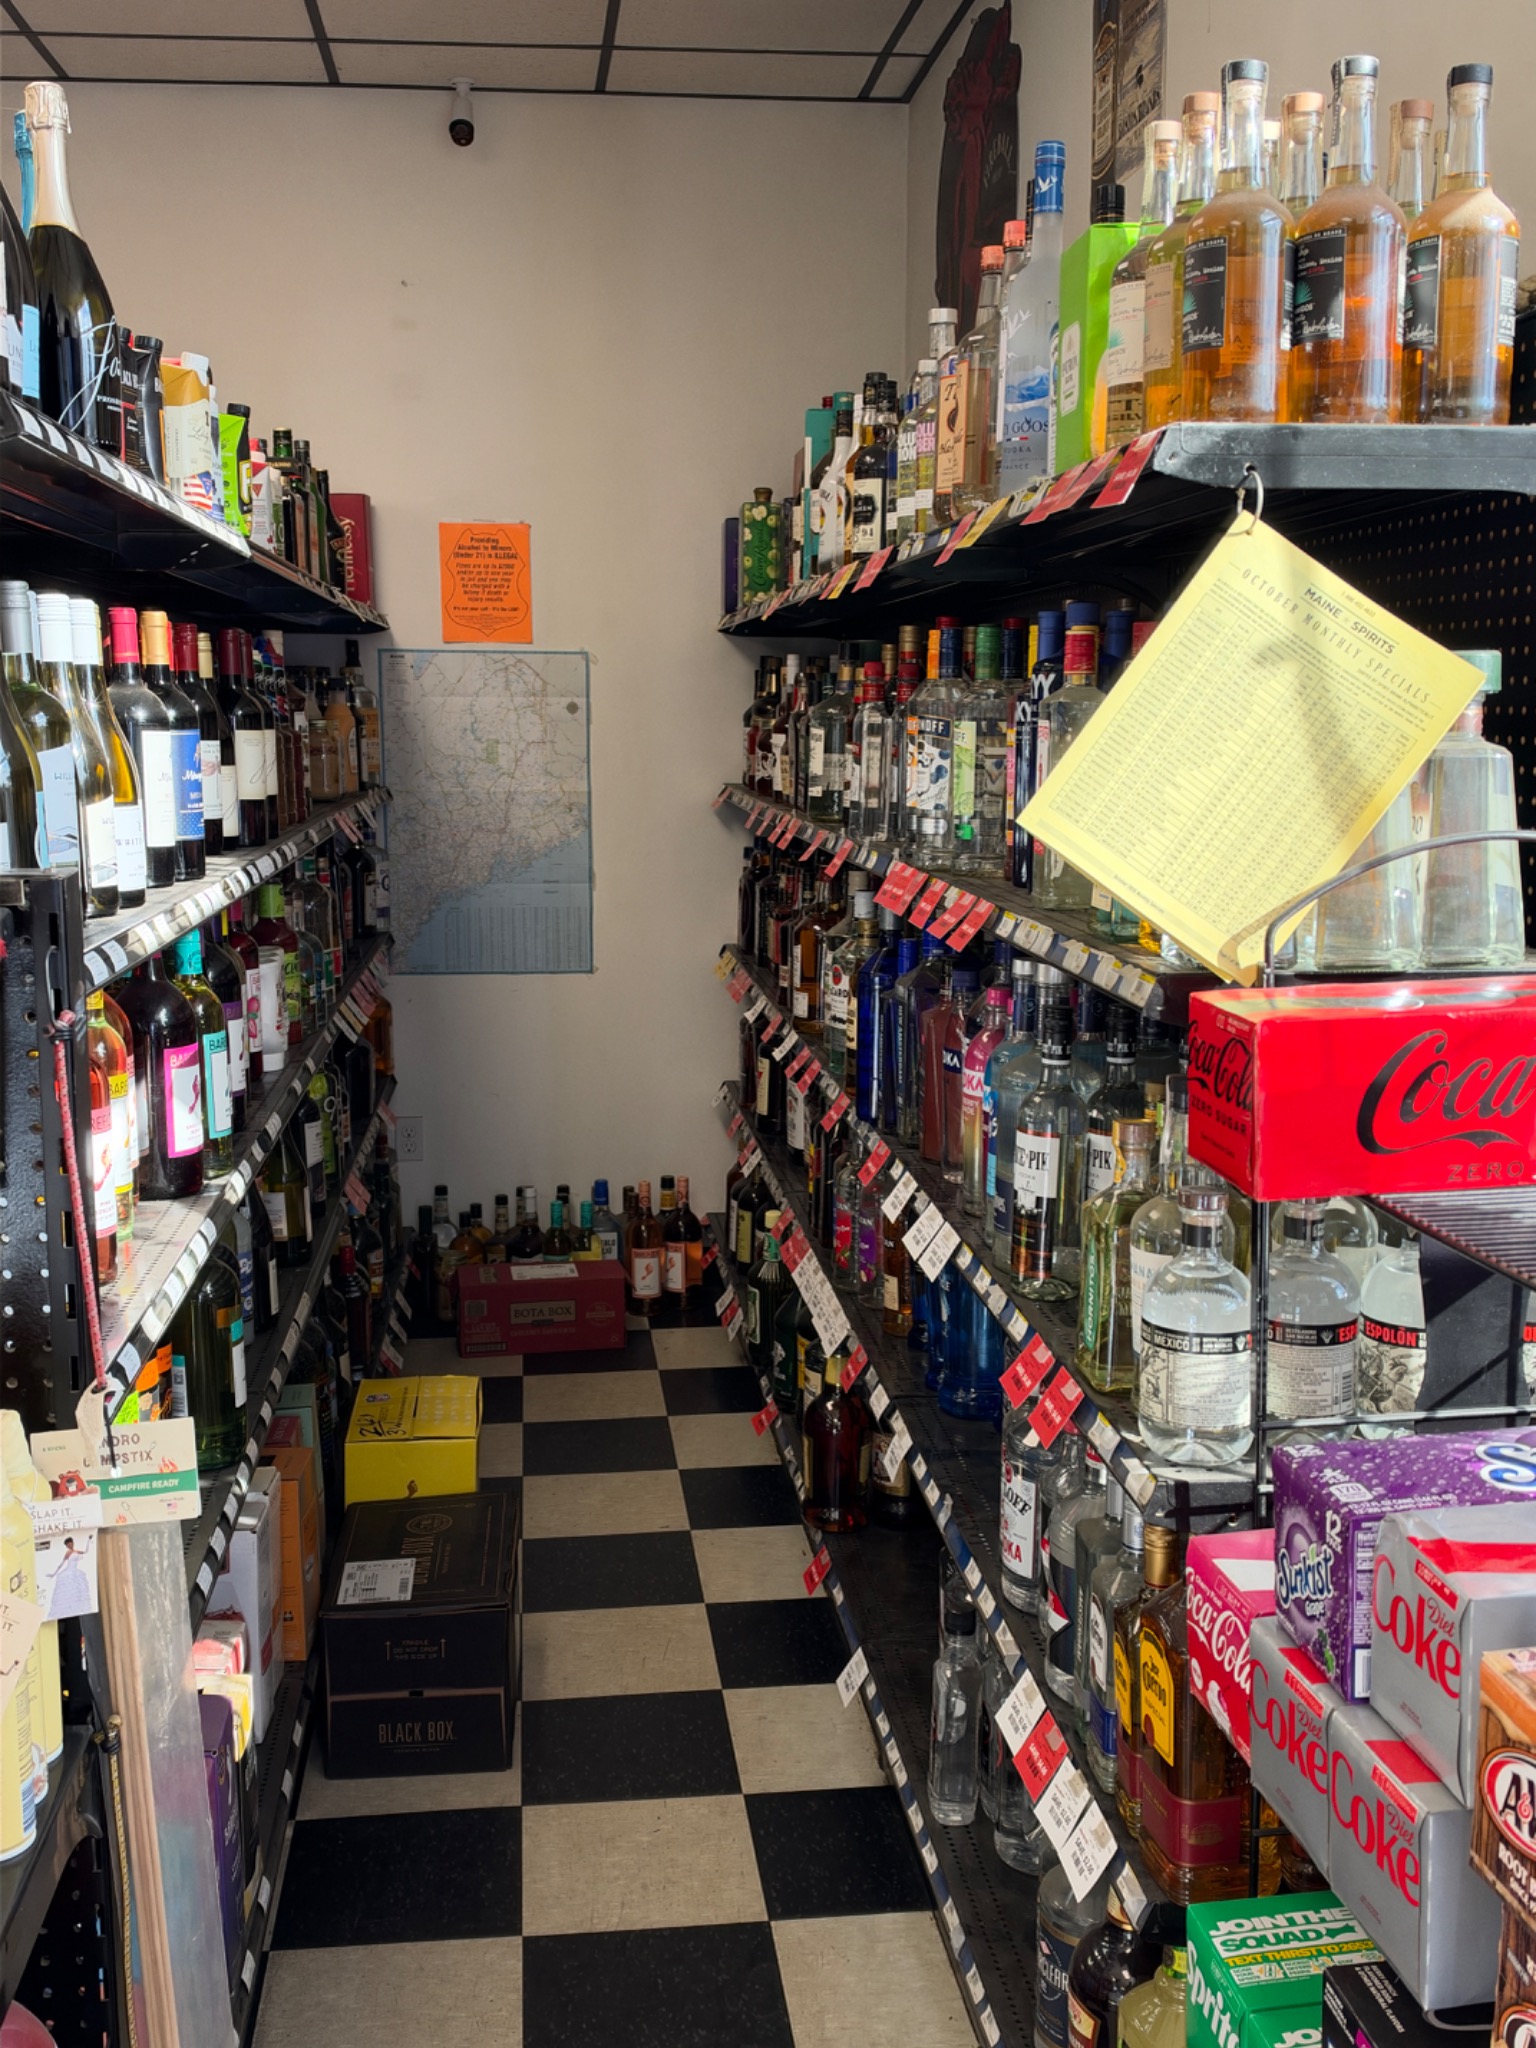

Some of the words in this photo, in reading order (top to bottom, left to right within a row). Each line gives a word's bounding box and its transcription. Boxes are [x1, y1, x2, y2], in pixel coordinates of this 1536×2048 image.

[1304, 587, 1342, 619] MAINE
[1351, 620, 1396, 655] SPIRITS
[1242, 567, 1300, 616] OCTOBER
[1303, 613, 1361, 660] MONTHLY
[1366, 657, 1431, 704] SPECIALS
[1192, 1094, 1213, 1119] ZERO
[1215, 1108, 1248, 1137] SUGAR
[1449, 1160, 1525, 1182] ZERO
[514, 1307, 545, 1319] BOTA
[550, 1305, 574, 1317] BOX
[108, 1481, 151, 1494] CAMPFIRE
[152, 1478, 180, 1488] READY
[31, 1509, 57, 1520] SLAP
[60, 1507, 72, 1517] IT.
[33, 1522, 69, 1535] SHAKE
[71, 1520, 84, 1529] IT.
[1326, 1510, 1341, 1537] 12
[1279, 1545, 1333, 1608] Sunkist
[1305, 1600, 1326, 1619] Grape
[1427, 1596, 1455, 1638] Diet
[1373, 1553, 1461, 1699] Coke
[1143, 1661, 1166, 1707] Cuervo
[379, 1722, 422, 1744] BLACK
[1250, 1659, 1328, 1795] Coke
[1297, 1702, 1322, 1740] Diet
[1029, 1742, 1039, 1761] SAVE:
[1051, 1792, 1062, 1811] SAVE:
[1331, 1750, 1421, 1908] Coke
[1386, 1803, 1415, 1847] Diet
[1075, 1837, 1086, 1857] SAVE:
[1498, 1842, 1528, 1886] ROOT
[1209, 1912, 1292, 1936] JOIN
[1284, 1907, 1355, 1928] THE
[1219, 1926, 1326, 1952] SQUAD
[1224, 1951, 1265, 1967] TEXT
[1266, 1946, 1320, 1961] THIRST
[1317, 1944, 1340, 1955] TO
